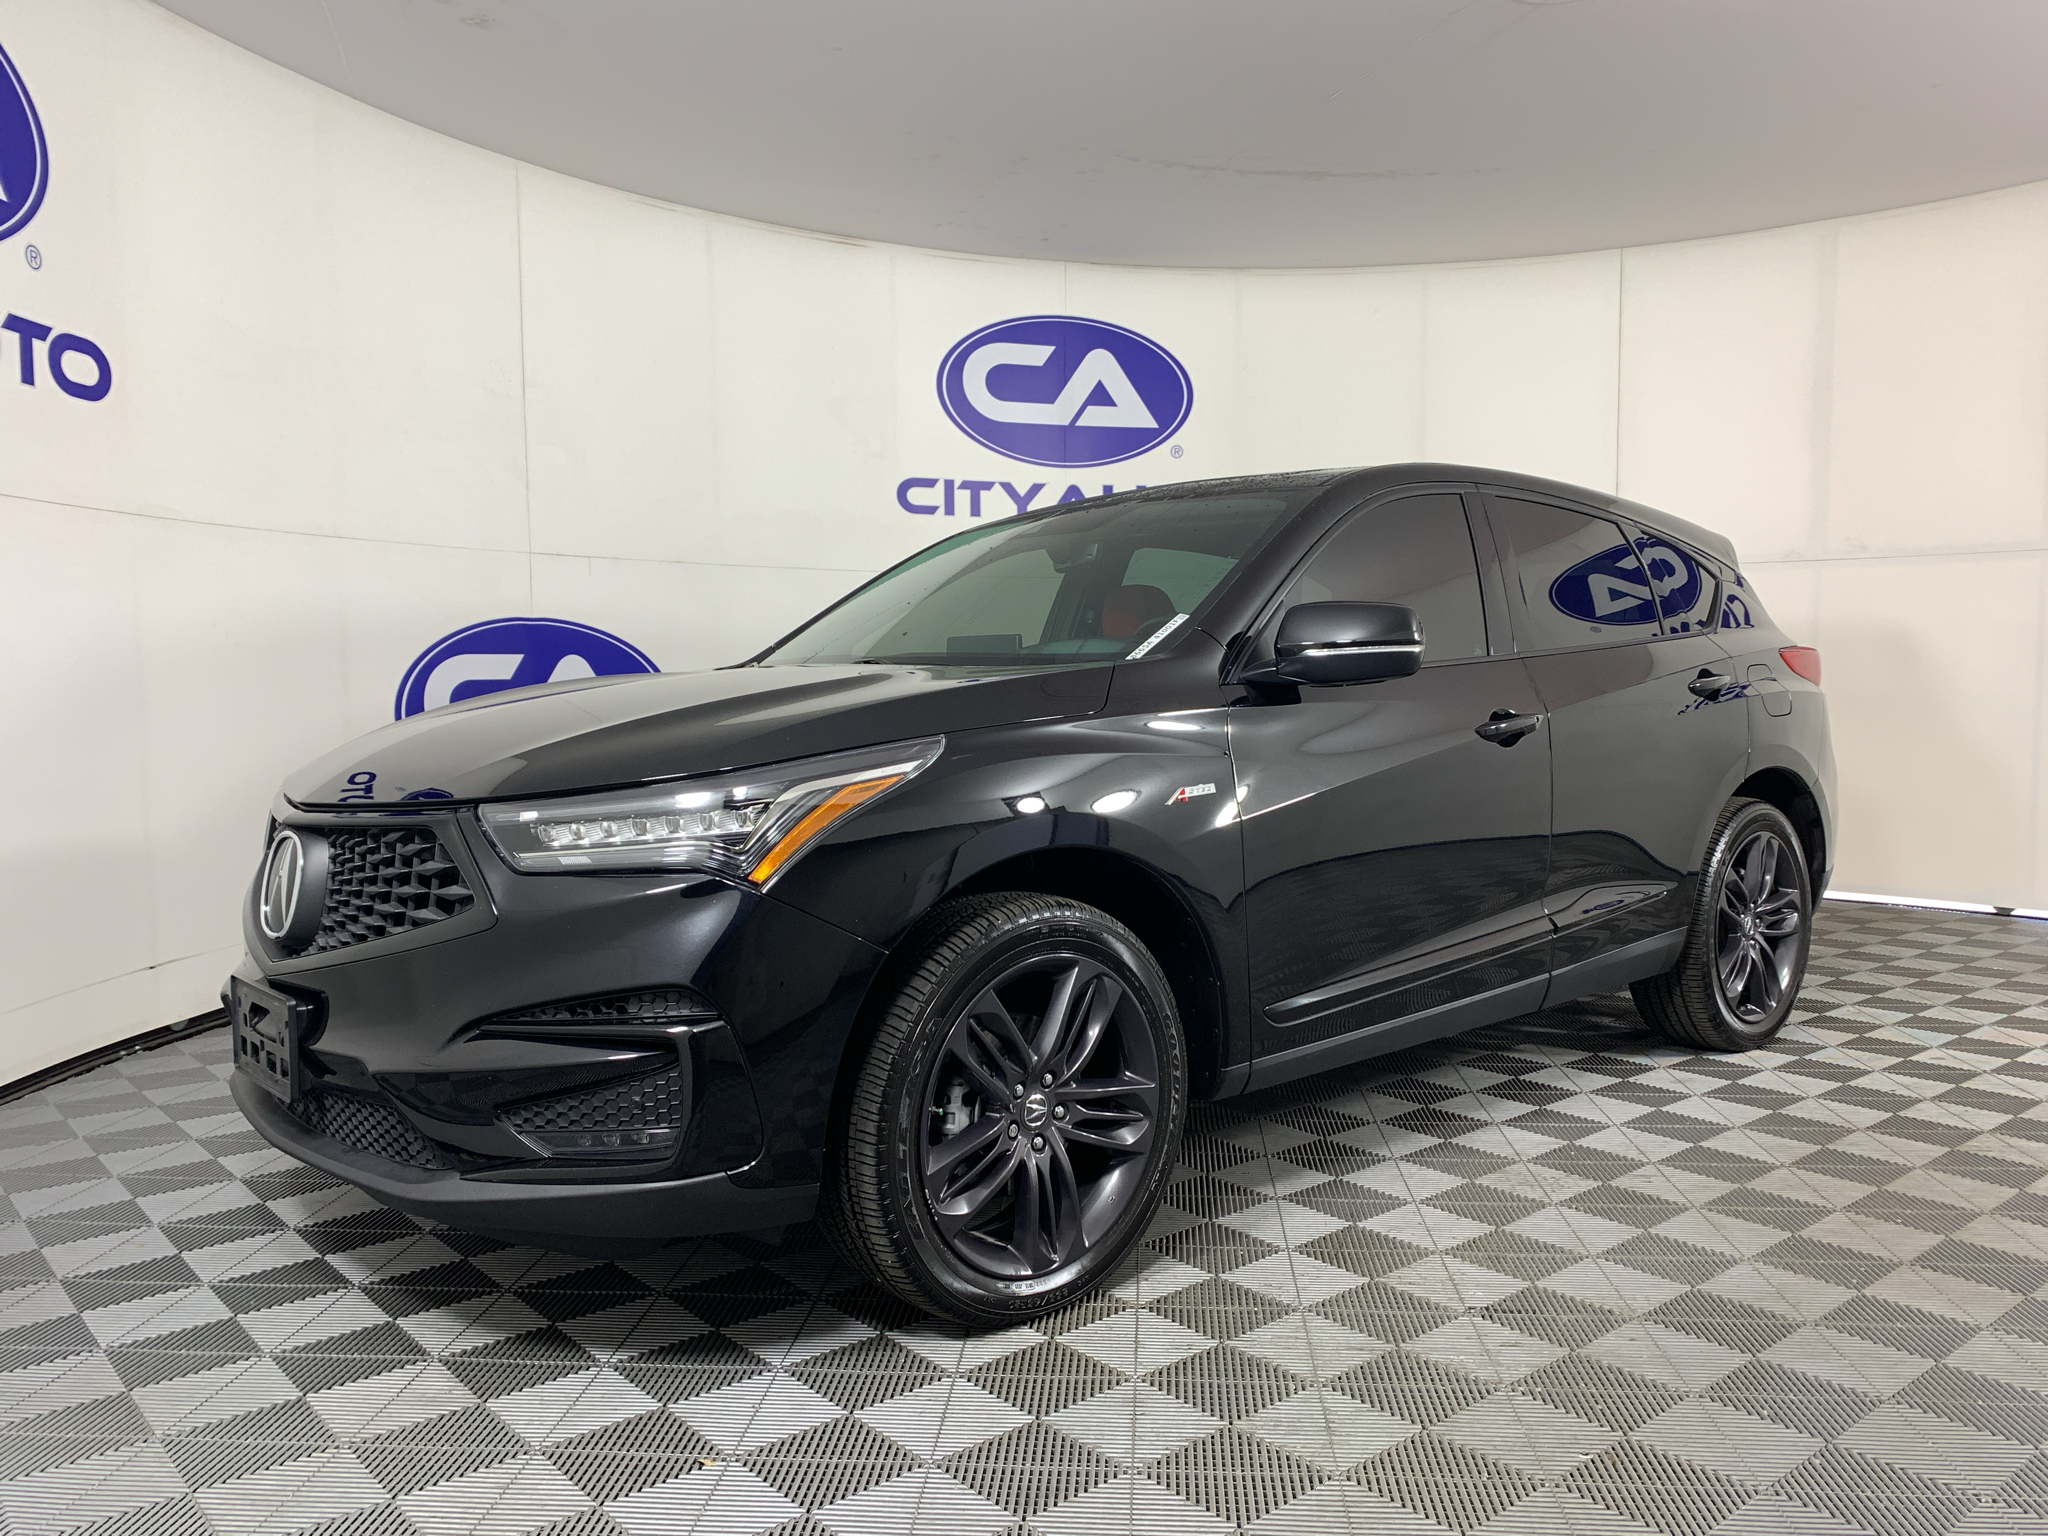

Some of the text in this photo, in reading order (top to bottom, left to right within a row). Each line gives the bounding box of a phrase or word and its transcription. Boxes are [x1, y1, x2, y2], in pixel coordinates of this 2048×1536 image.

[0, 312, 112, 402] TO
[962, 342, 1160, 429] CA
[896, 477, 1147, 517] CITY
